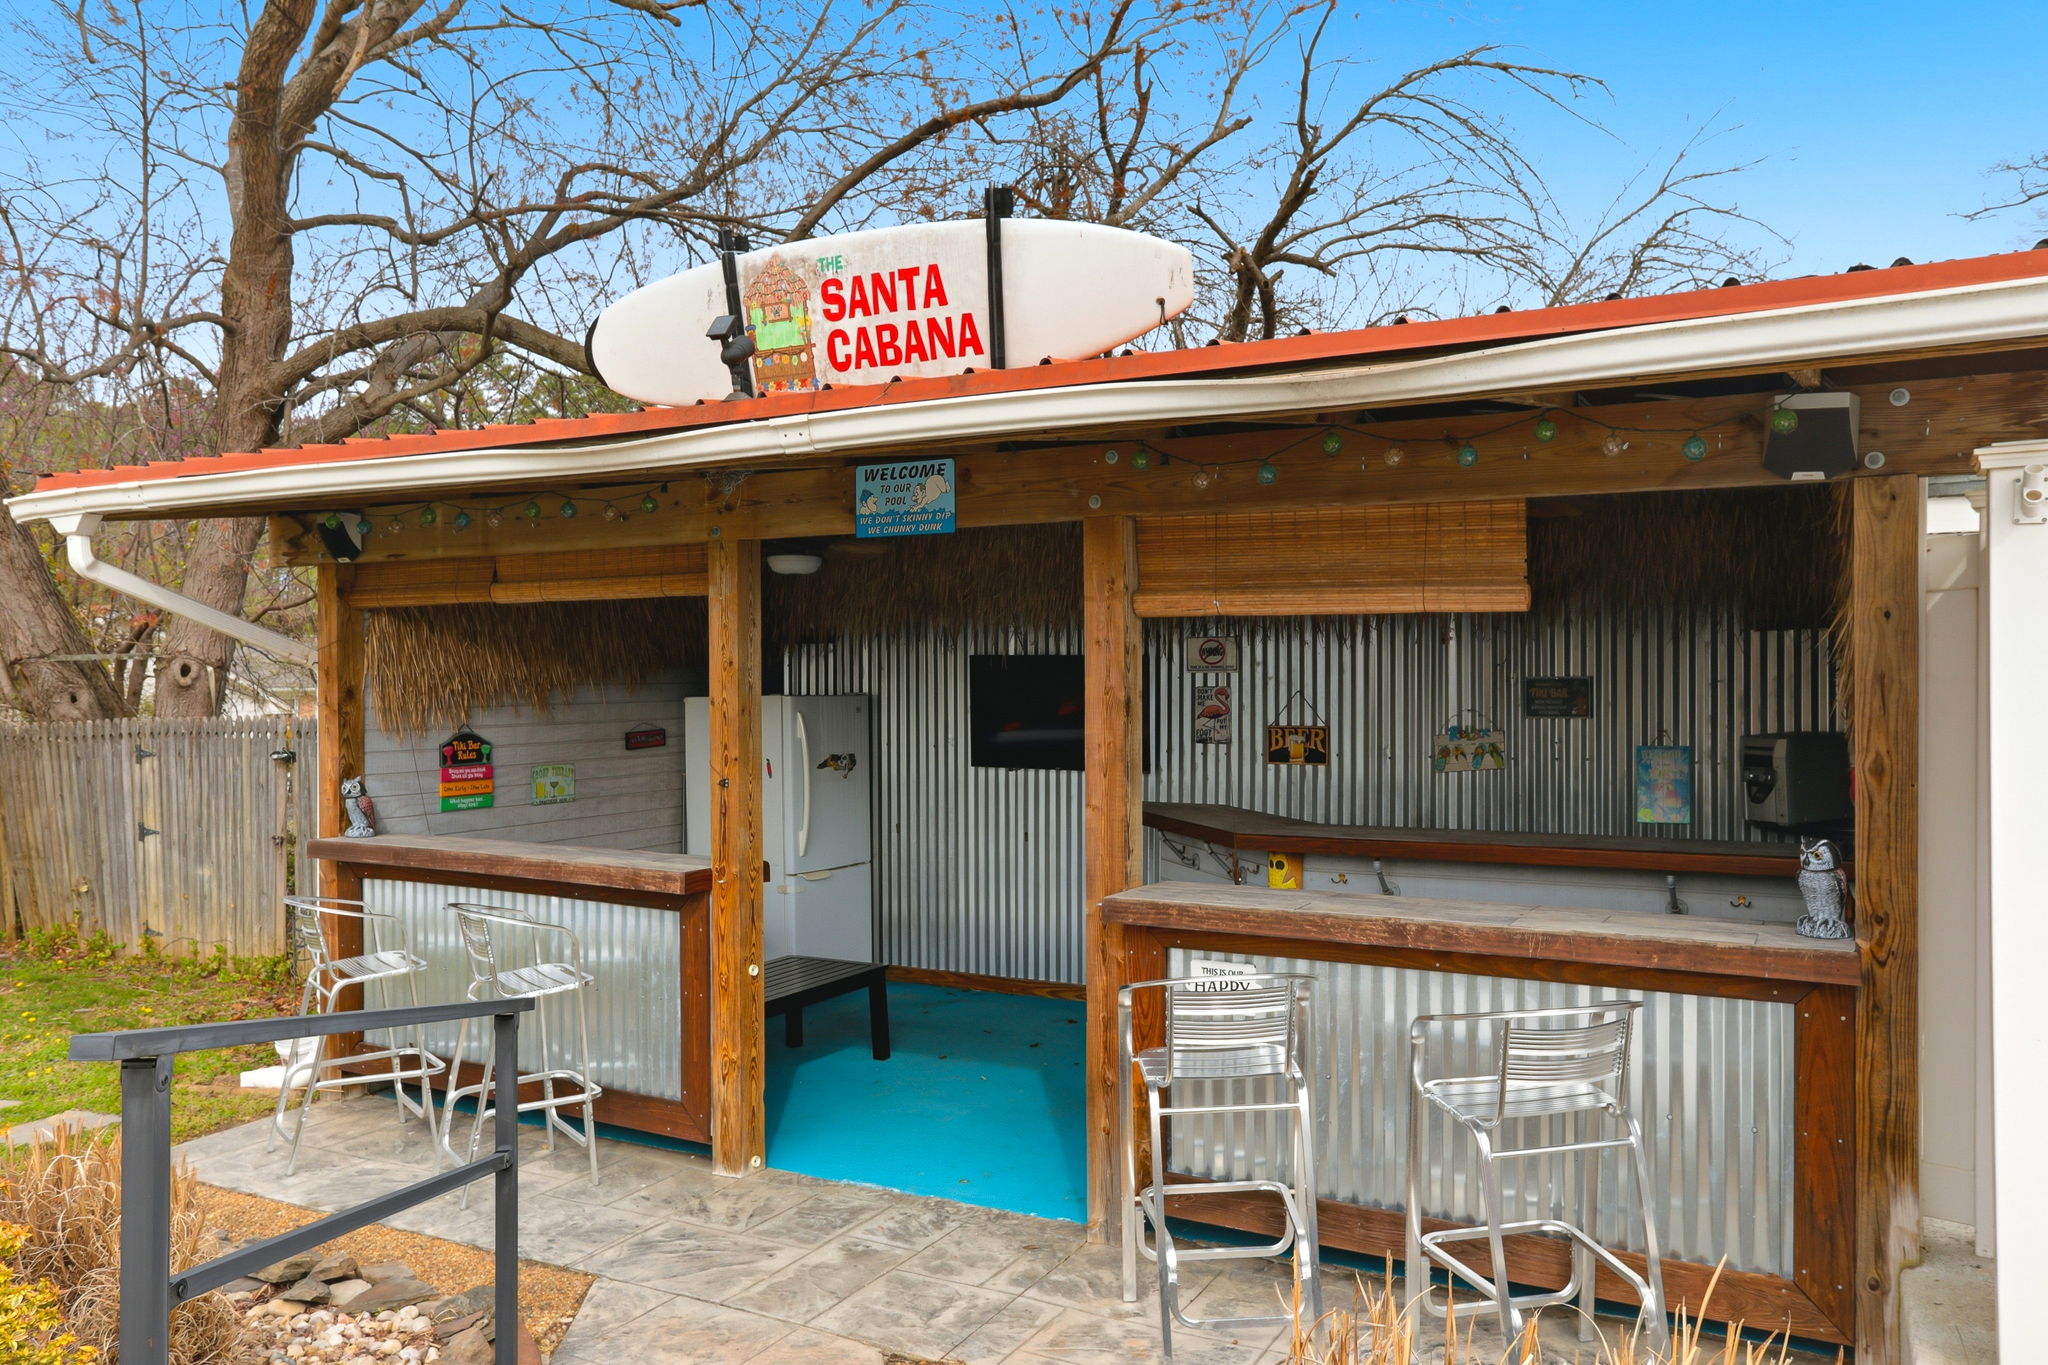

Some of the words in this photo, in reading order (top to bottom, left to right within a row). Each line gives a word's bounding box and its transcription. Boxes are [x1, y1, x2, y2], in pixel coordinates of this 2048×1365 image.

[816, 255, 844, 273] THE
[820, 263, 949, 322] SANTA
[827, 312, 985, 373] CABANA
[864, 463, 946, 482] WELCOME
[880, 485, 890, 494] TO
[894, 483, 912, 493] OUR
[885, 496, 907, 506] POOL
[860, 517, 872, 525] WE
[875, 514, 900, 524] DON'T
[903, 513, 933, 523] SKINNY
[936, 511, 951, 520] DIP
[868, 526, 880, 534] WE
[884, 524, 916, 534] CHUNKY
[918, 523, 942, 532] DUNK
[452, 740, 467, 751] Tiki
[467, 740, 481, 750] Bar
[1270, 728, 1325, 752] BEER
[457, 750, 477, 760] Rules
[1201, 967, 1218, 976] THIS
[1220, 968, 1227, 976] IS
[1195, 980, 1250, 992] HAPPY
